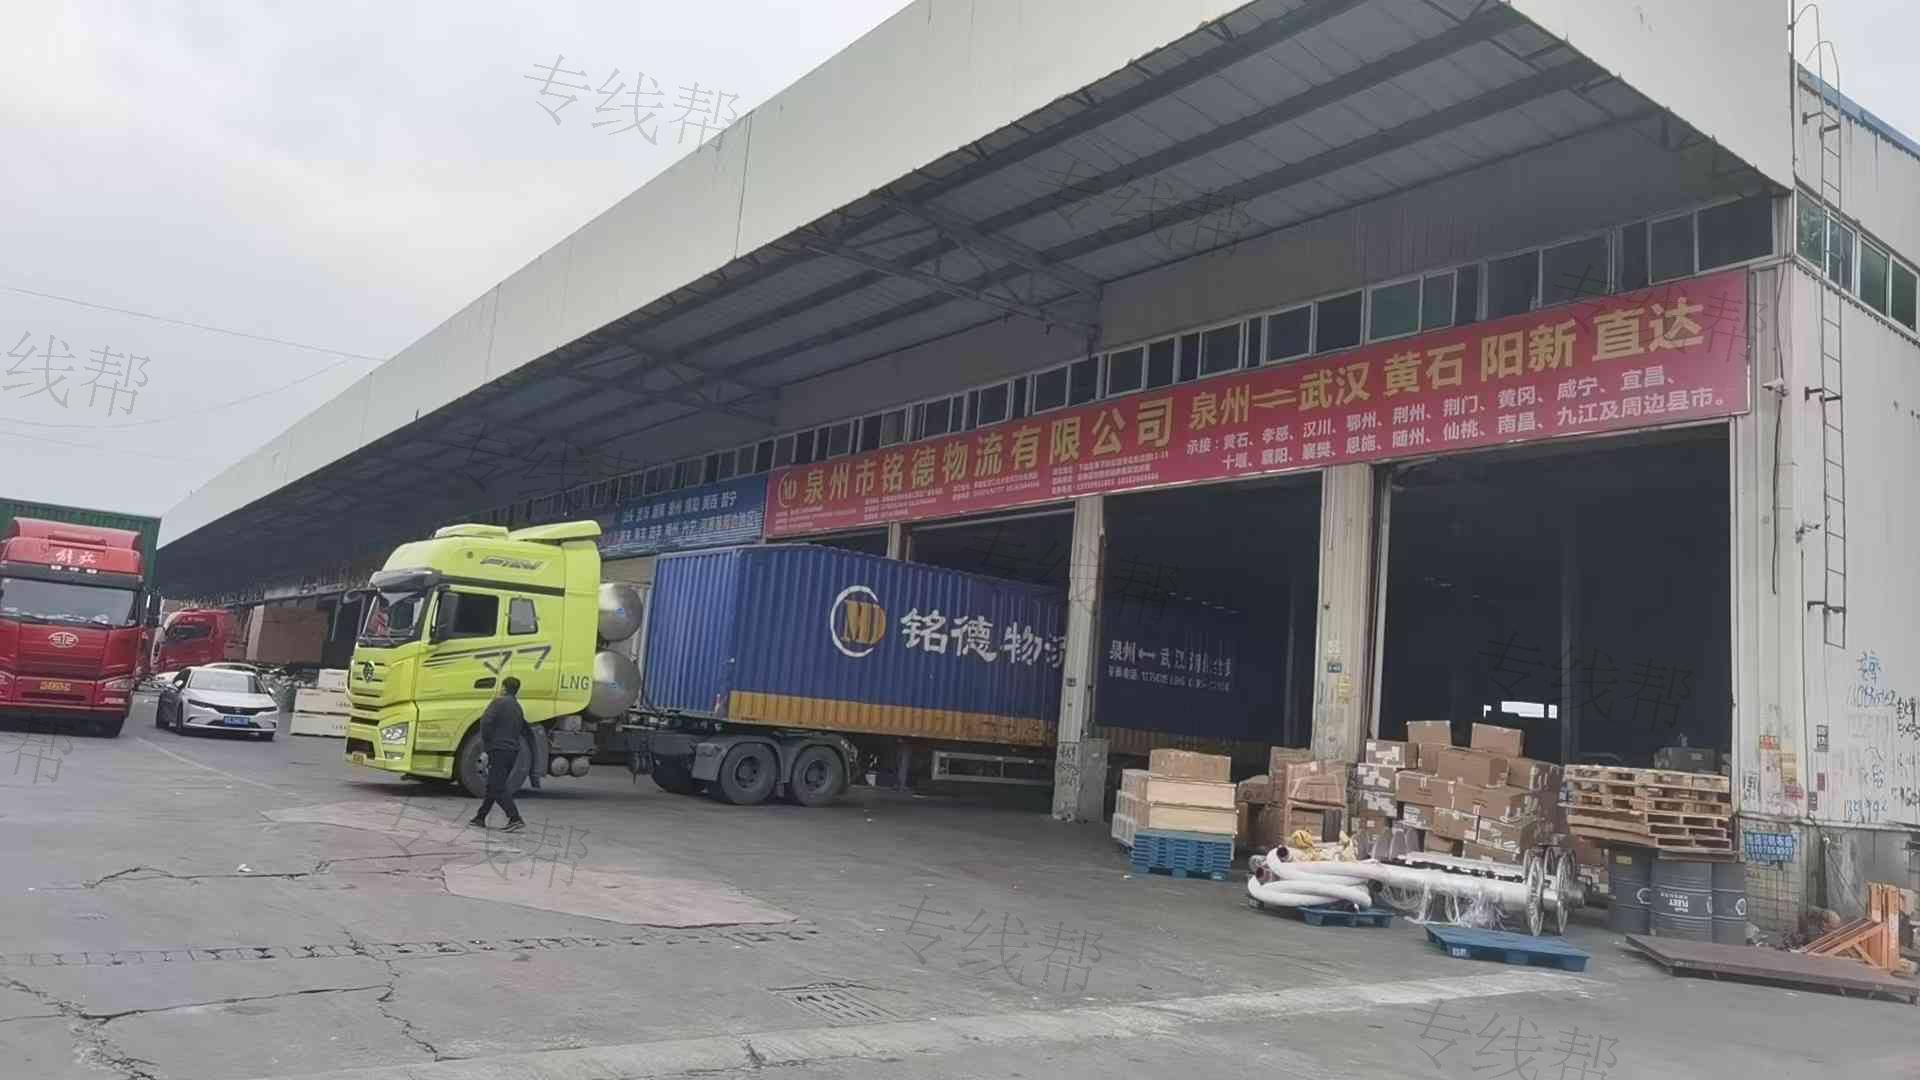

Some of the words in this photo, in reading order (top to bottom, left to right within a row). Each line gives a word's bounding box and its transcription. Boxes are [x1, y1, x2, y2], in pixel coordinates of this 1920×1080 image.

[1190, 384, 1249, 430] 泉州
[1298, 360, 1369, 411] 武汉
[1383, 343, 1468, 397] 黄石
[1480, 318, 1577, 382] 阳新
[1592, 297, 1705, 362] 直达
[803, 396, 1174, 504] 泉州市铭德物流有限公司
[561, 674, 590, 690] LNG
